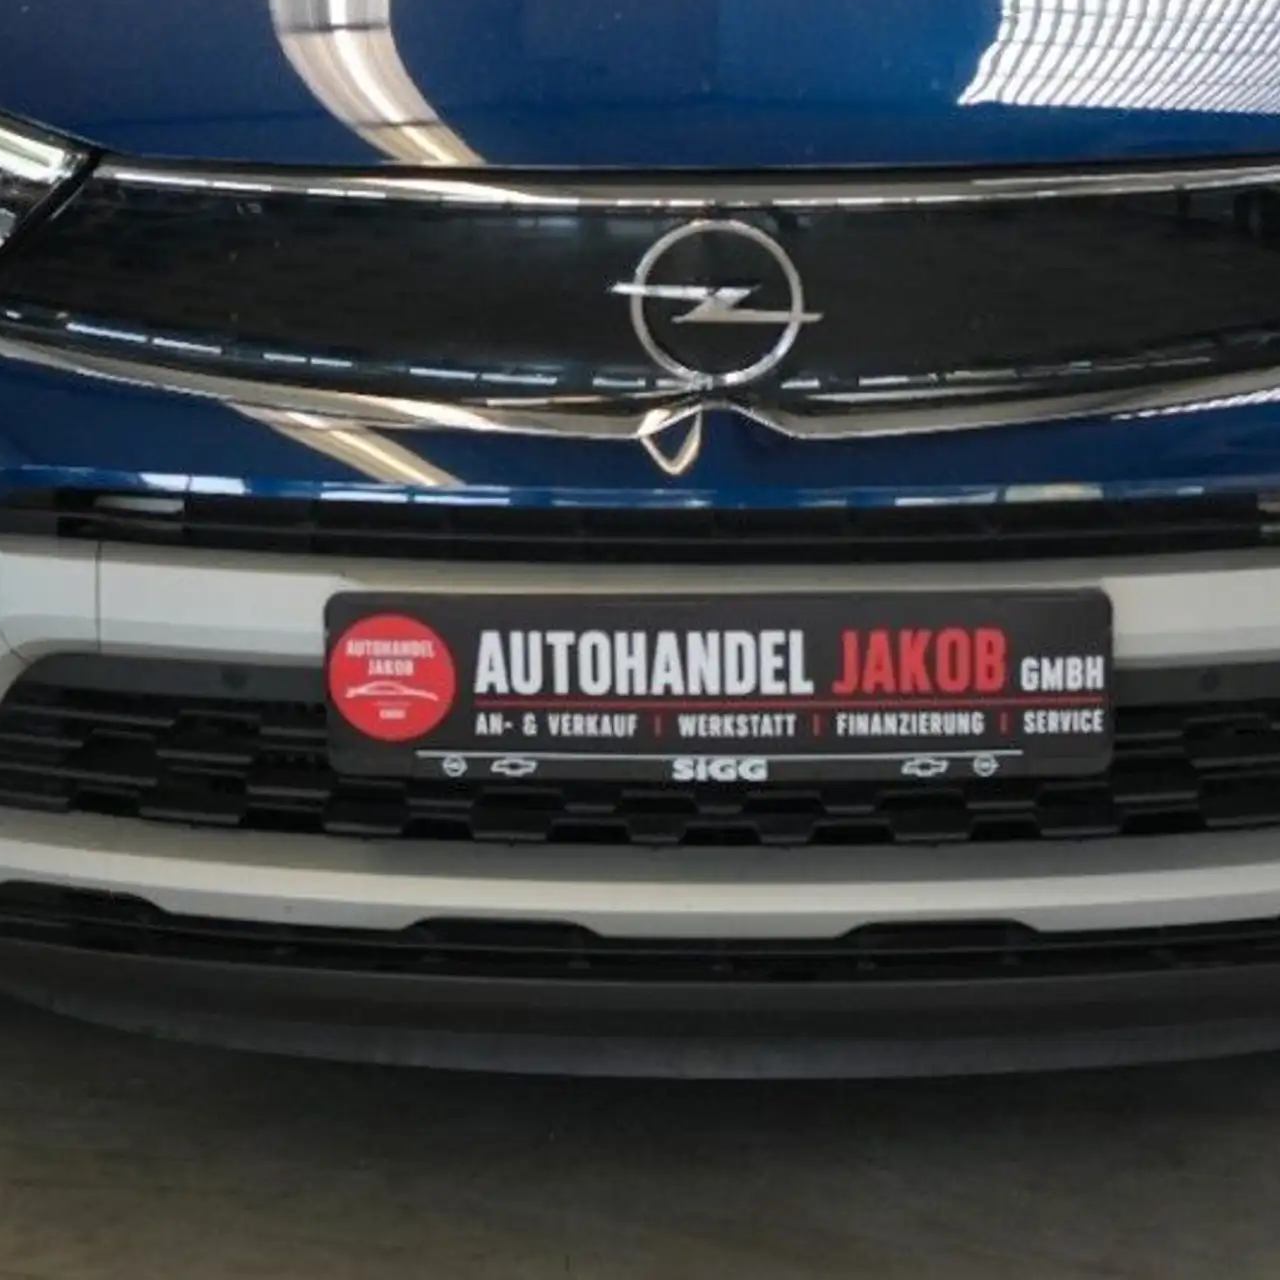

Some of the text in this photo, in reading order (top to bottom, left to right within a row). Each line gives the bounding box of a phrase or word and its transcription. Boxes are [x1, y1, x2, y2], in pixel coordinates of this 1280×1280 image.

[474, 627, 1104, 697] AUTOHANDEL JAKOB GMBH
[475, 710, 1104, 737] AN- & VERKAUF WERKSTATT FINANZIERUNG SERVICE
